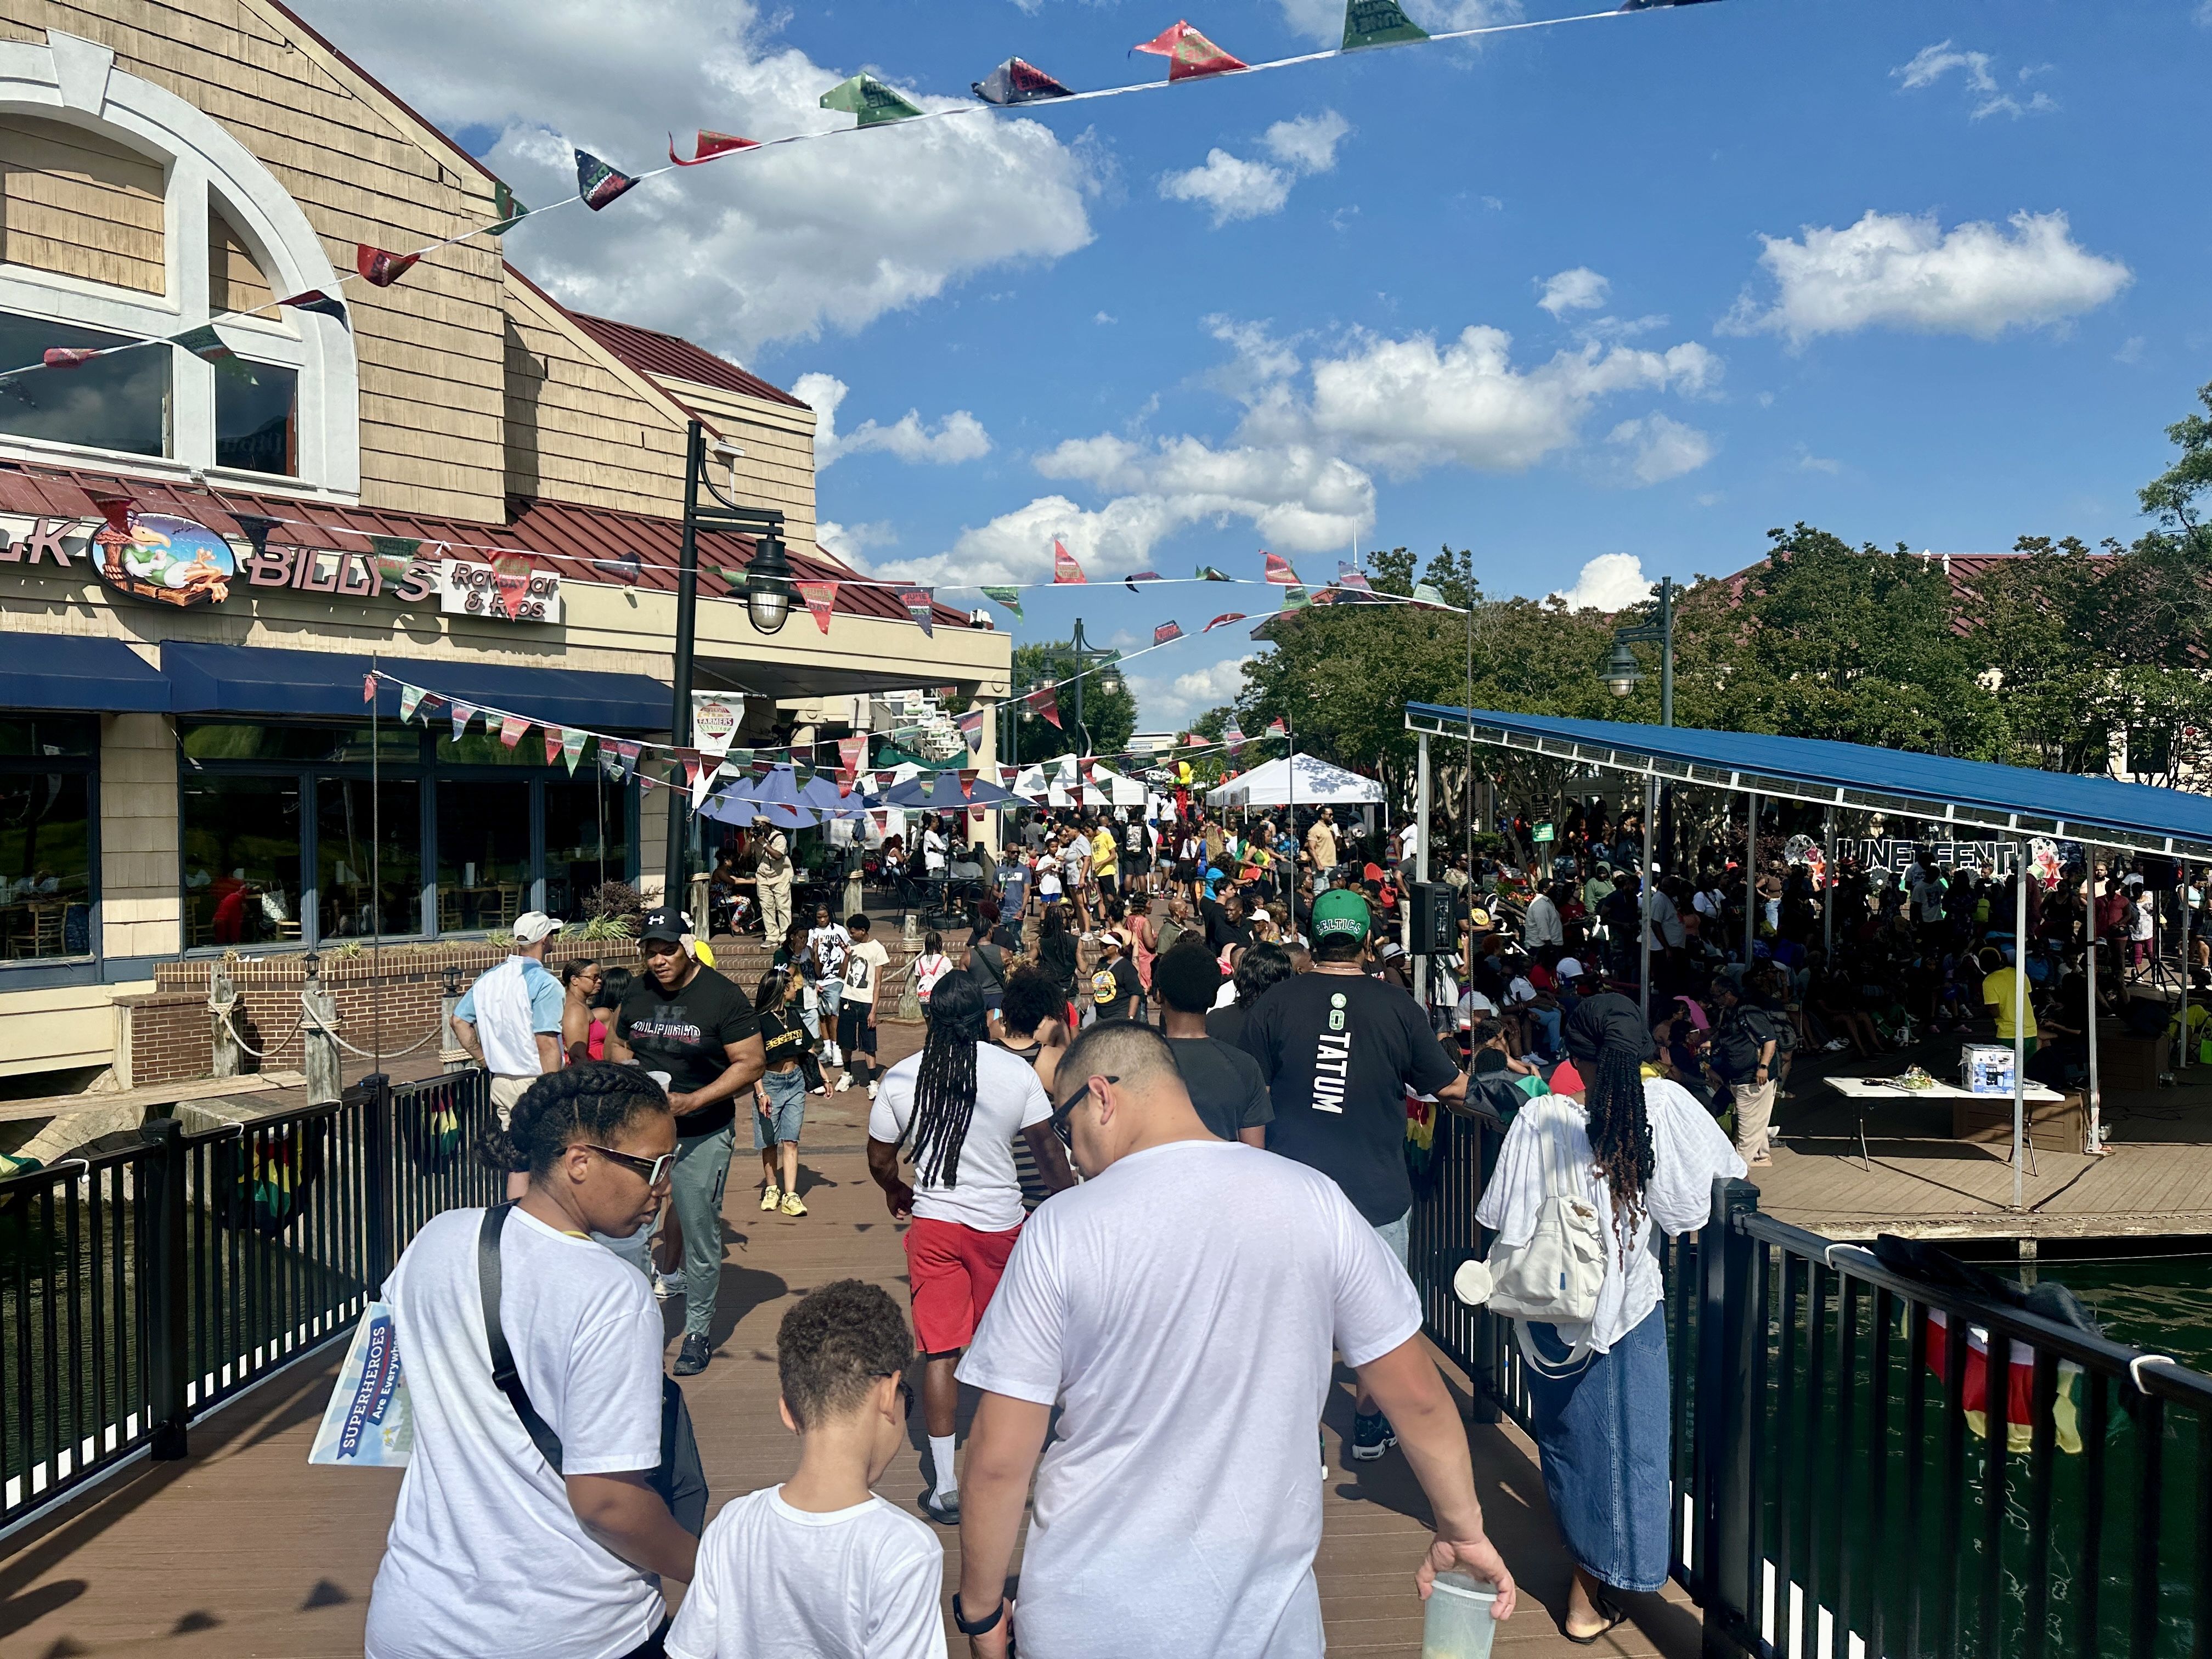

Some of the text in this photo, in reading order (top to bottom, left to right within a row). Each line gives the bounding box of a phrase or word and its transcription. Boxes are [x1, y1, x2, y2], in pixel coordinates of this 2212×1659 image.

[379, 558, 405, 571] DAY
[500, 579, 525, 589] DAY
[465, 591, 483, 611] &
[809, 603, 830, 612] DAY
[1316, 918, 1361, 935] CELTICS
[1312, 1031, 1351, 1114] TATUM
[343, 1326, 385, 1448] SUPERHEROES
[372, 1398, 386, 1419] Are
